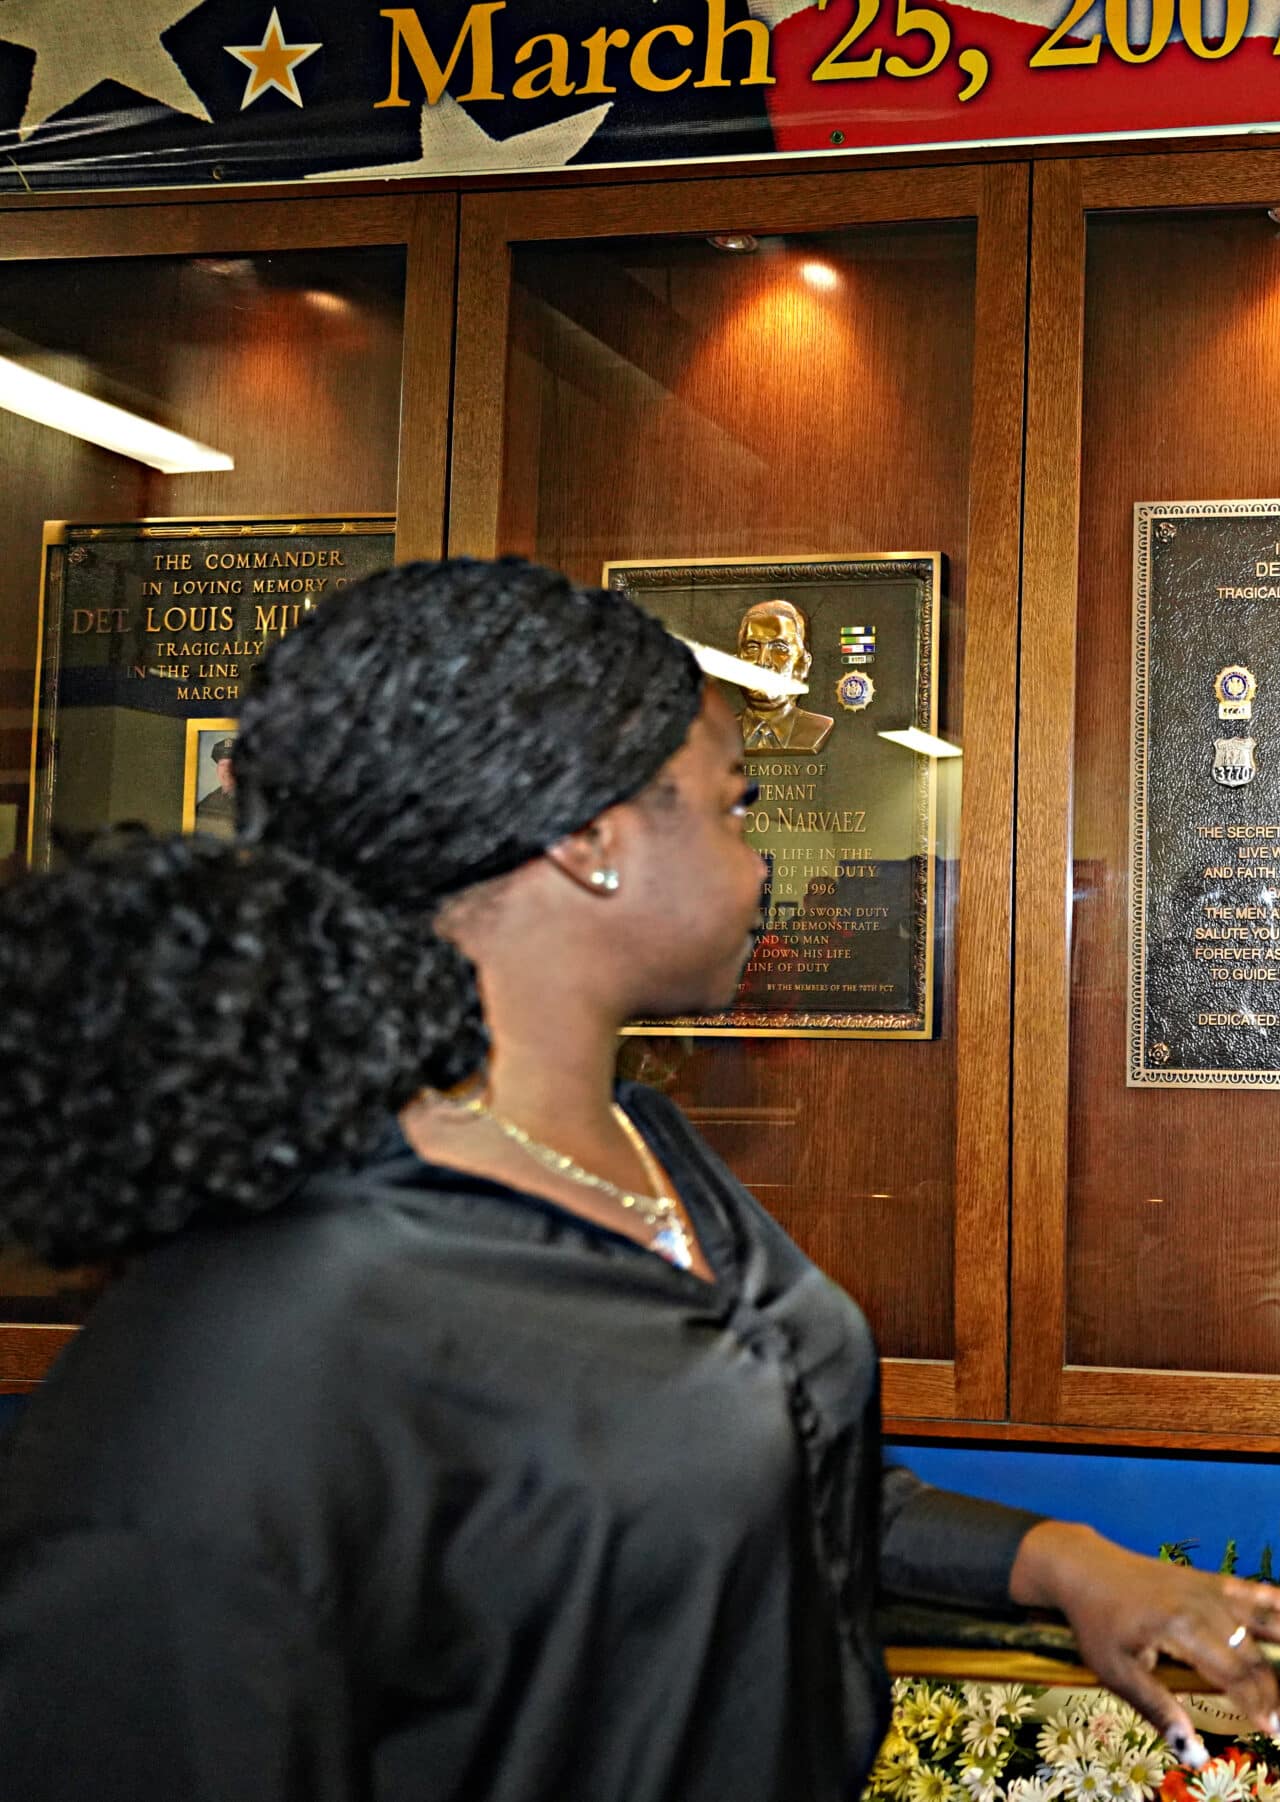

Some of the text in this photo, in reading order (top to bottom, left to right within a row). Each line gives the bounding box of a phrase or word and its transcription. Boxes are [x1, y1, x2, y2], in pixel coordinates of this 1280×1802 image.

[374, 0, 776, 108] March
[811, 0, 989, 101] 25,
[154, 552, 344, 571] THE COMMANDER
[143, 580, 162, 595] IN
[172, 580, 242, 595] LOVING
[253, 579, 327, 594] MEMORY
[145, 605, 234, 632] LOUIS
[157, 642, 263, 656] TRAGICALLY
[127, 665, 146, 679] IN
[159, 665, 190, 679] THE
[199, 664, 239, 678] LINE
[177, 685, 238, 700] MARCH
[807, 764, 827, 776] OF
[1219, 765, 1250, 780] 3770
[1197, 826, 1223, 838] THE
[783, 849, 812, 859] LIFE
[820, 849, 836, 859] IN
[841, 849, 872, 859] THE
[1239, 847, 1269, 858] LIVE
[778, 865, 797, 877] OF
[804, 865, 828, 877] HIS
[834, 865, 877, 877] DUTY
[1204, 867, 1233, 878] AND
[805, 884, 835, 895] 1996
[790, 908, 806, 917] TO
[810, 908, 851, 917] SWORN
[856, 908, 889, 917] DUTY
[1205, 908, 1232, 920] THE
[1236, 908, 1266, 920] MEN
[792, 921, 880, 930] DEMONSTRATE
[755, 936, 829, 944] AND TO MAN
[1195, 928, 1248, 940] SALUTE
[762, 949, 799, 958] DOWN
[803, 949, 823, 958] HIS
[827, 949, 851, 958] LIFE
[1195, 949, 1261, 960] FOREVER
[747, 963, 830, 972] LINE OF DUTY
[1211, 969, 1229, 981] TO
[1232, 969, 1277, 981] GUIDE
[1198, 1014, 1276, 1027] DEDICATED
